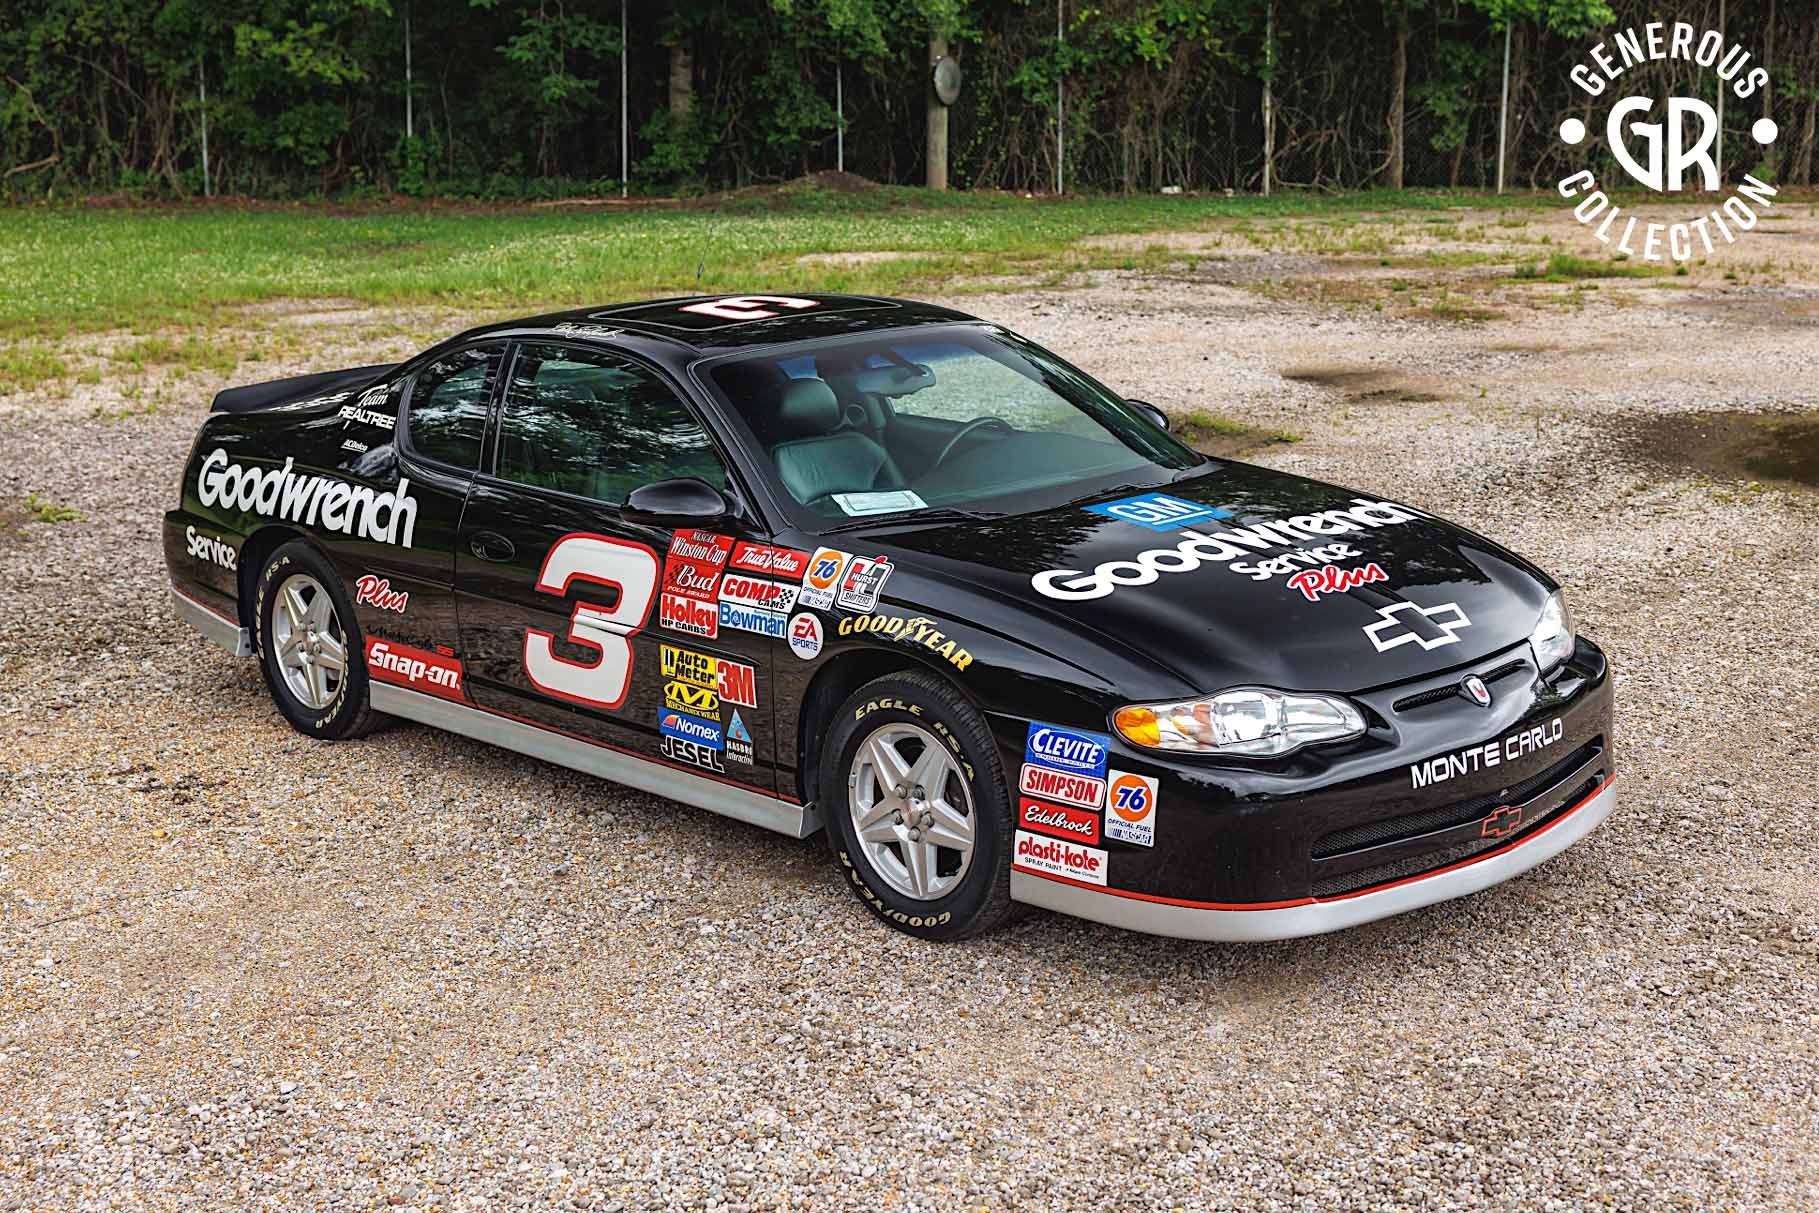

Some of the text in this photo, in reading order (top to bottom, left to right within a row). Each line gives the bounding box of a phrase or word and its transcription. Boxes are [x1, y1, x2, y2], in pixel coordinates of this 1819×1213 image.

[357, 384, 389, 408] Team
[338, 405, 397, 430] REALTREE
[198, 447, 418, 549] Goodwrench
[1107, 497, 1204, 522] GM
[185, 525, 238, 571] Service
[670, 536, 728, 566] Winston Cup
[1031, 498, 1426, 601] Goodwrench
[1227, 541, 1363, 582] Service
[676, 564, 720, 592] Bud
[813, 560, 839, 580] 76
[850, 572, 878, 585] HURST
[1285, 561, 1390, 602] Plus
[356, 574, 409, 613] Plus
[667, 585, 687, 594] POLE
[723, 578, 781, 602] COMP
[843, 592, 872, 605] SHIFTERS
[662, 594, 718, 637] Holley
[758, 598, 787, 611] CAMS
[523, 532, 661, 709] 3
[662, 618, 706, 635] HP CARBS
[720, 602, 786, 638] Bowman
[793, 617, 818, 641] EA
[792, 637, 818, 652] SPORTS
[838, 614, 974, 672] GOODYEAR
[368, 642, 459, 690] Snap-on
[677, 651, 708, 669] Auto
[675, 665, 715, 684] Meter
[717, 660, 755, 706] 3M
[855, 698, 924, 720] EAGLE
[676, 718, 719, 742] Nomex
[660, 735, 725, 773] JESEL
[1032, 728, 1102, 764] CLEVITE
[1411, 717, 1563, 789] MONTE CARLO
[1026, 769, 1099, 803] SIMPSON
[1114, 785, 1146, 813] 76
[1024, 805, 1093, 837] Edelbrock
[1107, 818, 1152, 833] OFFICIAL FUEL
[1018, 837, 1100, 872] plasti-kote
[1024, 857, 1062, 872] SPRAY PAINT
